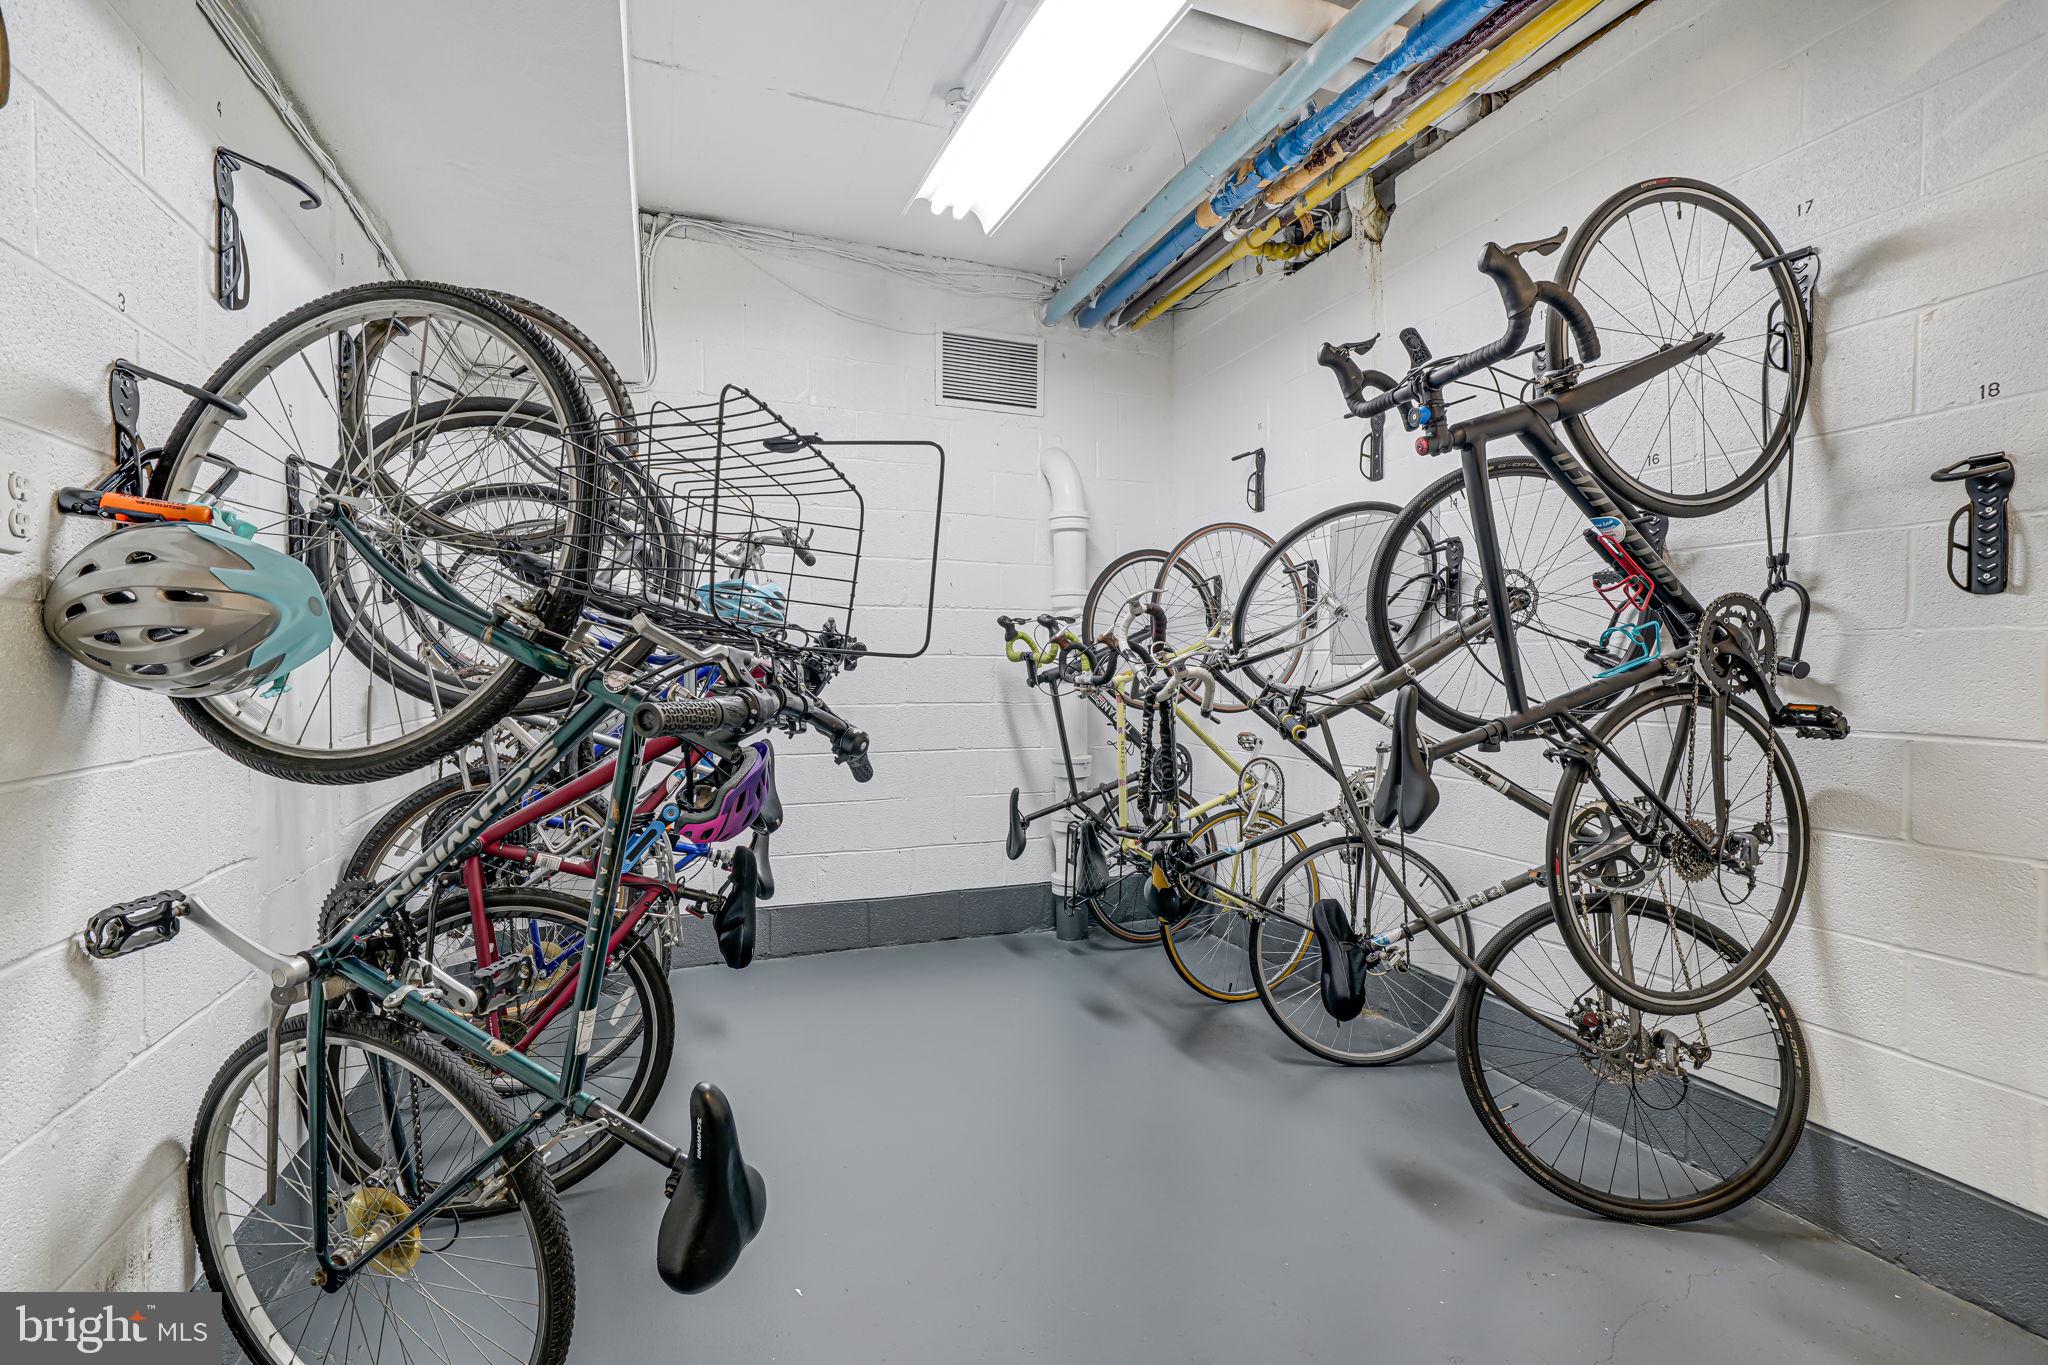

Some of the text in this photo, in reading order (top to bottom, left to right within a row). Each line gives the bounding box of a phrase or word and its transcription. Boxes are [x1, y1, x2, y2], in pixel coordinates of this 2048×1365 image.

[1797, 199, 1814, 216] 17
[118, 293, 126, 312] 3
[1979, 382, 2000, 400] 18
[1647, 453, 1660, 467] 16
[1552, 452, 1684, 597] SPECILIZED
[386, 739, 559, 908] SCHWINN
[586, 827, 616, 951] TRANSIT
